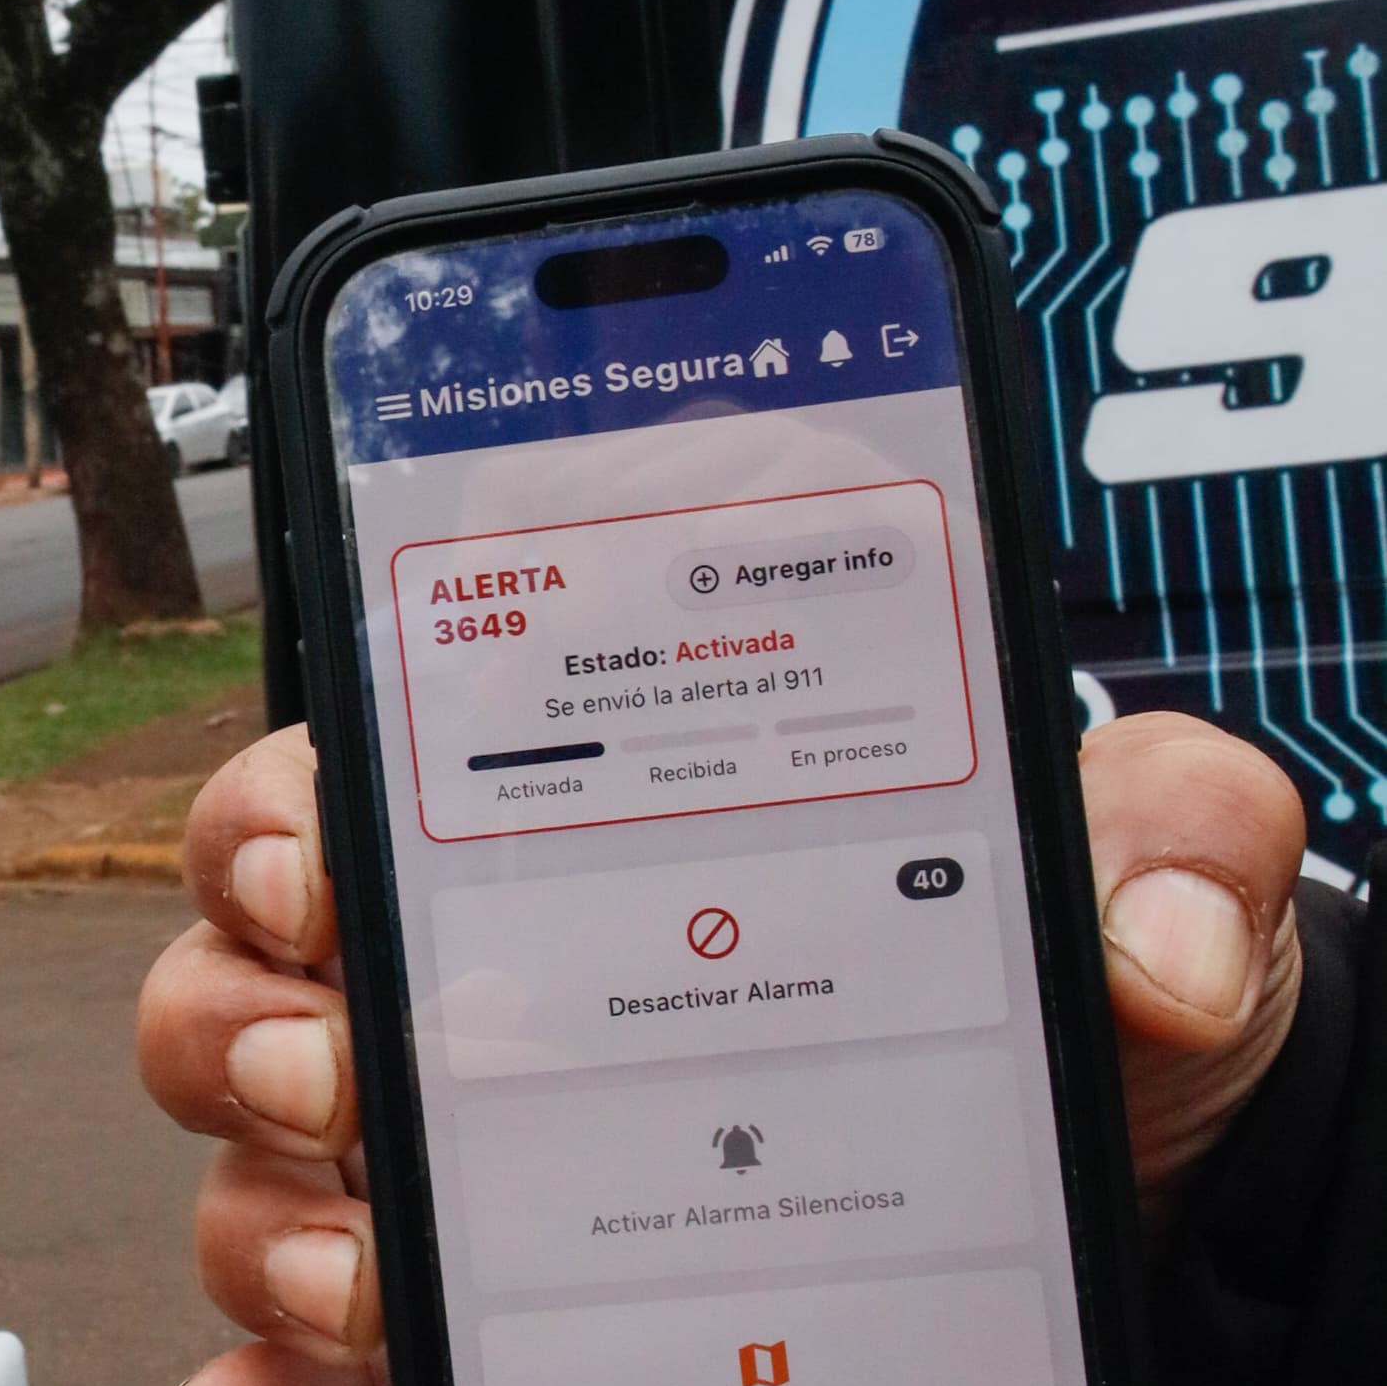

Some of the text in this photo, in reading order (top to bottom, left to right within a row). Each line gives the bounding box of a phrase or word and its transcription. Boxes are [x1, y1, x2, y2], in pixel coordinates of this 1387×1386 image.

[851, 230, 876, 249] 78
[404, 285, 473, 313] 10:29
[420, 351, 746, 418] Misiones Segura
[430, 565, 566, 605] ALERTA
[734, 547, 894, 586] Agregar info
[434, 611, 527, 646] 3649
[565, 629, 795, 677] Estado: Activada
[545, 667, 824, 719] Se envió la alerta al 911
[649, 757, 737, 784] Recibida
[791, 742, 907, 771] En proceso
[496, 775, 584, 801] Activada
[912, 868, 948, 891] 40
[608, 976, 835, 1017] Desactivar Alarma
[590, 1188, 906, 1236] Activar Alarma Silenciosa
